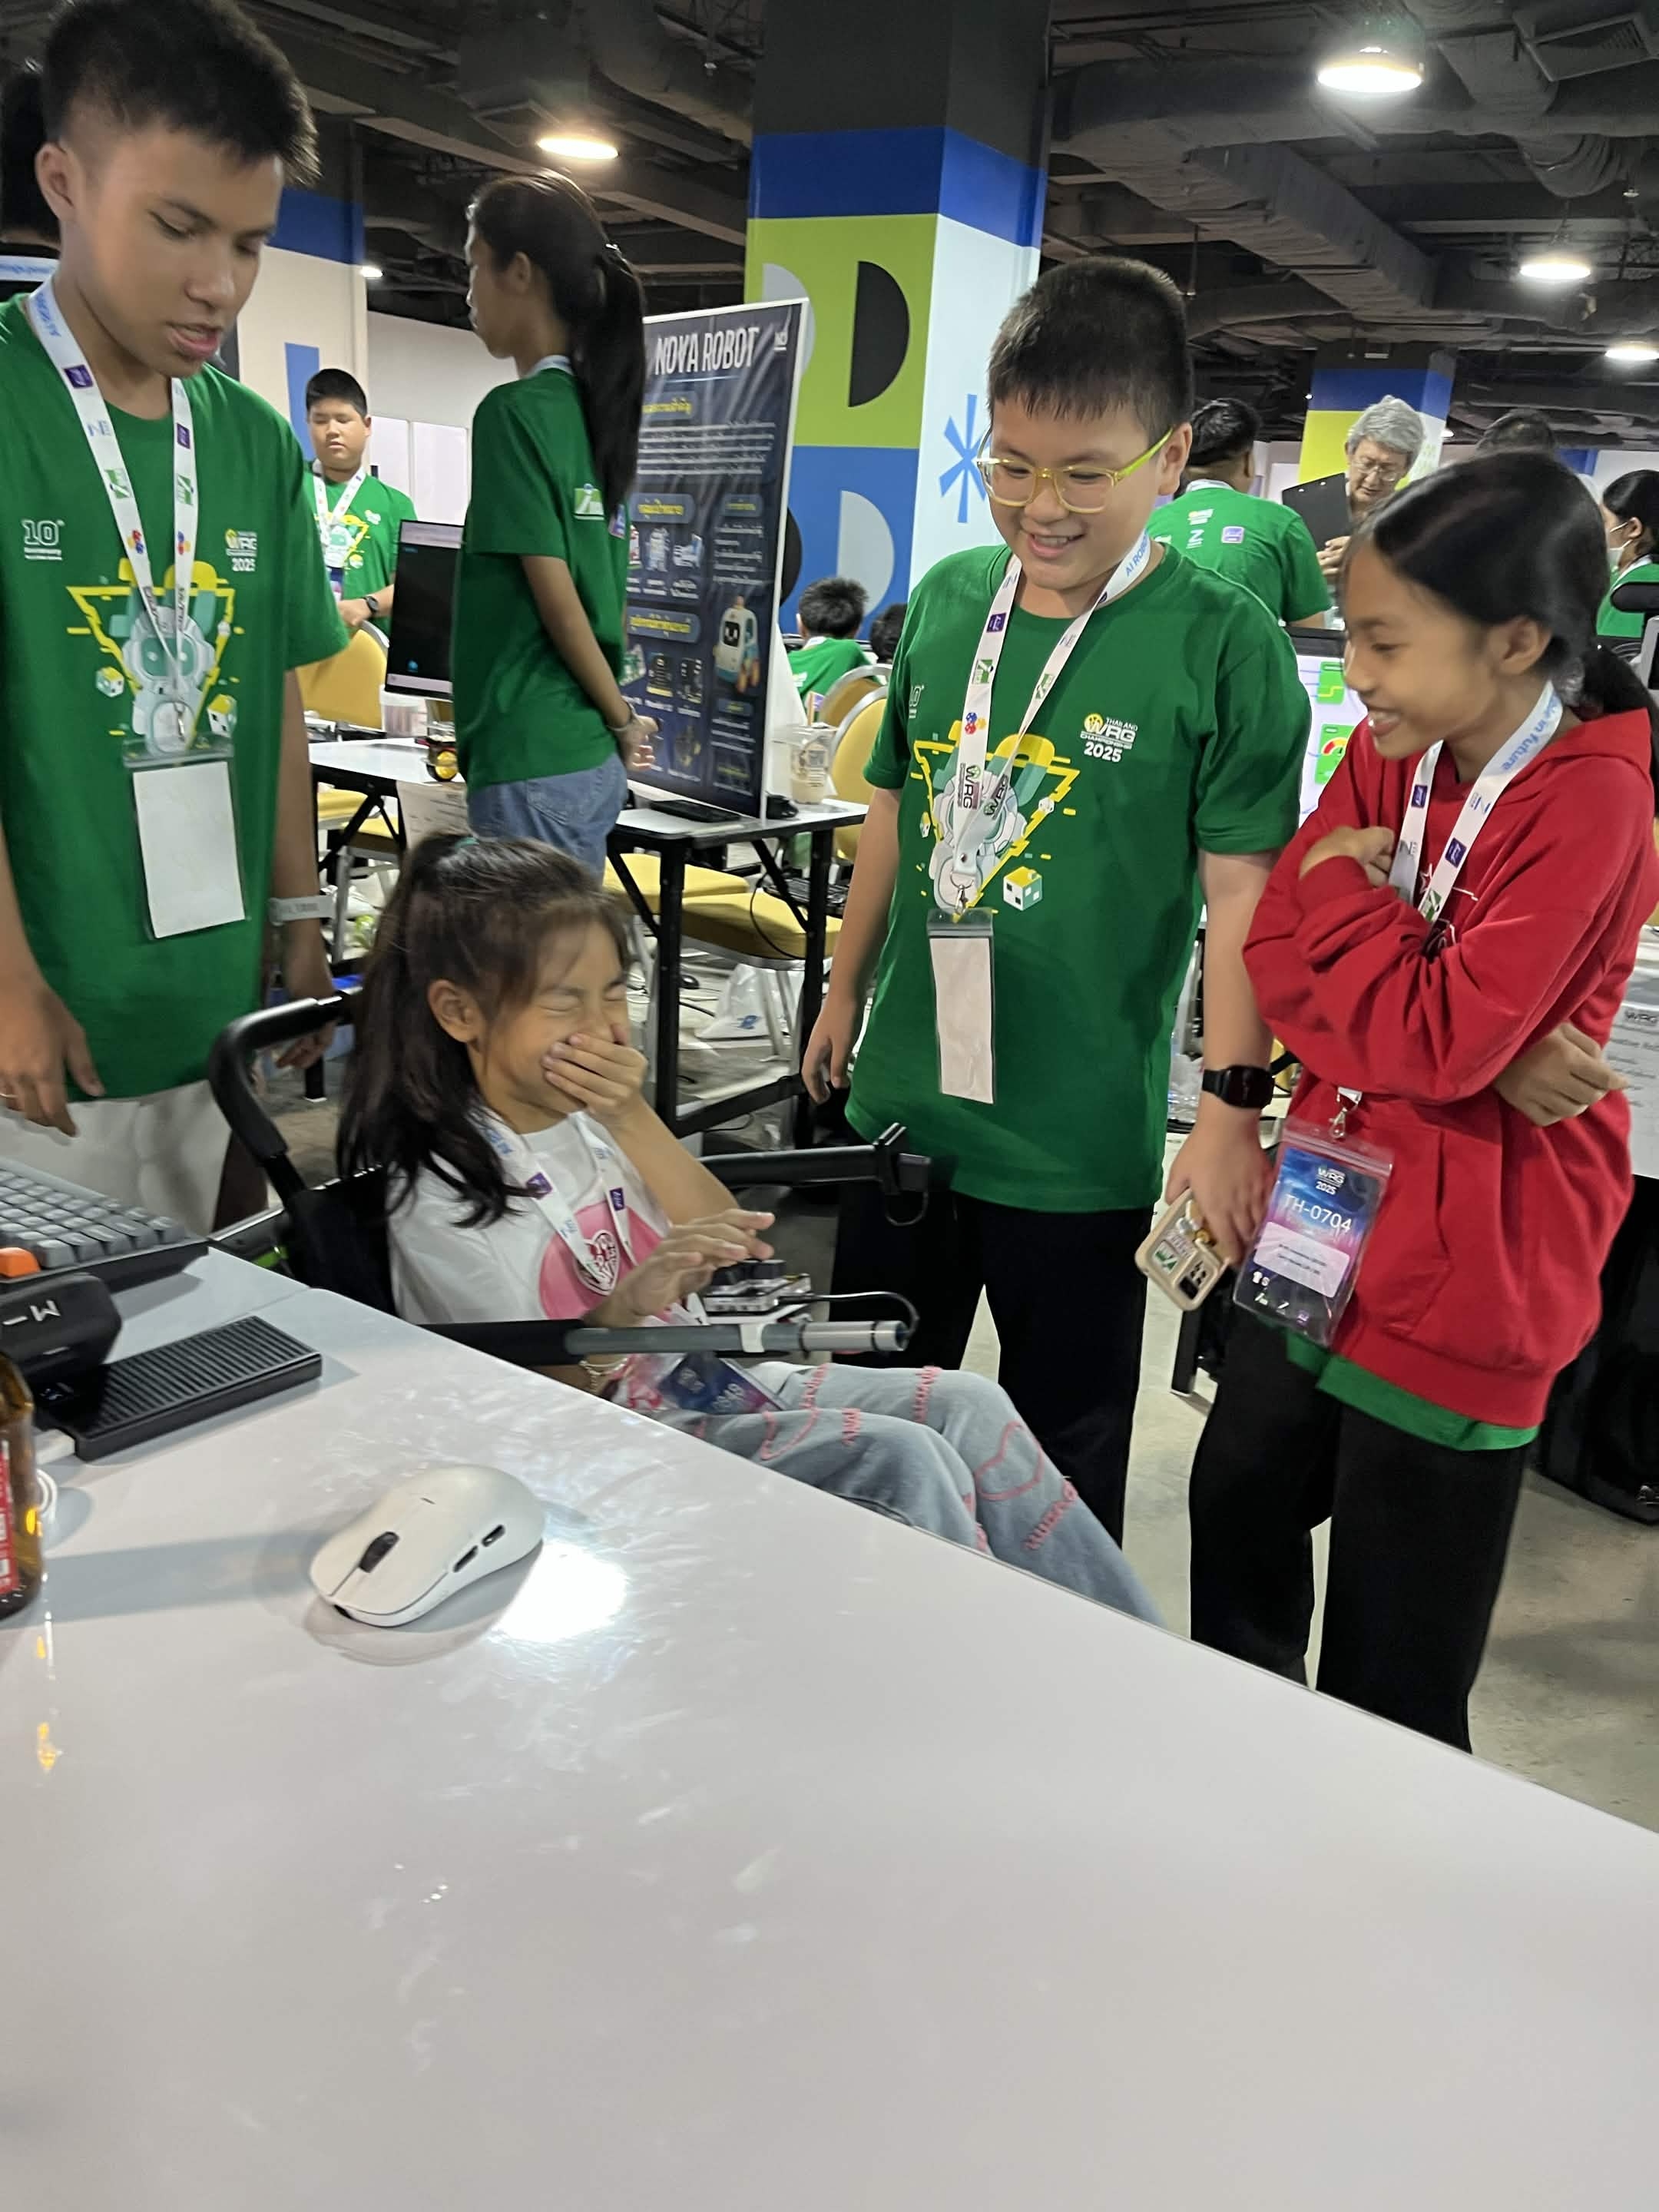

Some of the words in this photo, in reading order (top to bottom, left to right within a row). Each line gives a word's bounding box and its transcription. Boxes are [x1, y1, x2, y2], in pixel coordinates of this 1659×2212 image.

[702, 327, 760, 372] ROBOT
[1085, 722, 1136, 743] WRG
[1084, 740, 1124, 763] 2025
[963, 764, 980, 810] WRG
[1315, 1181, 1337, 1195] 2025
[1284, 1194, 1353, 1233] TH-0704
